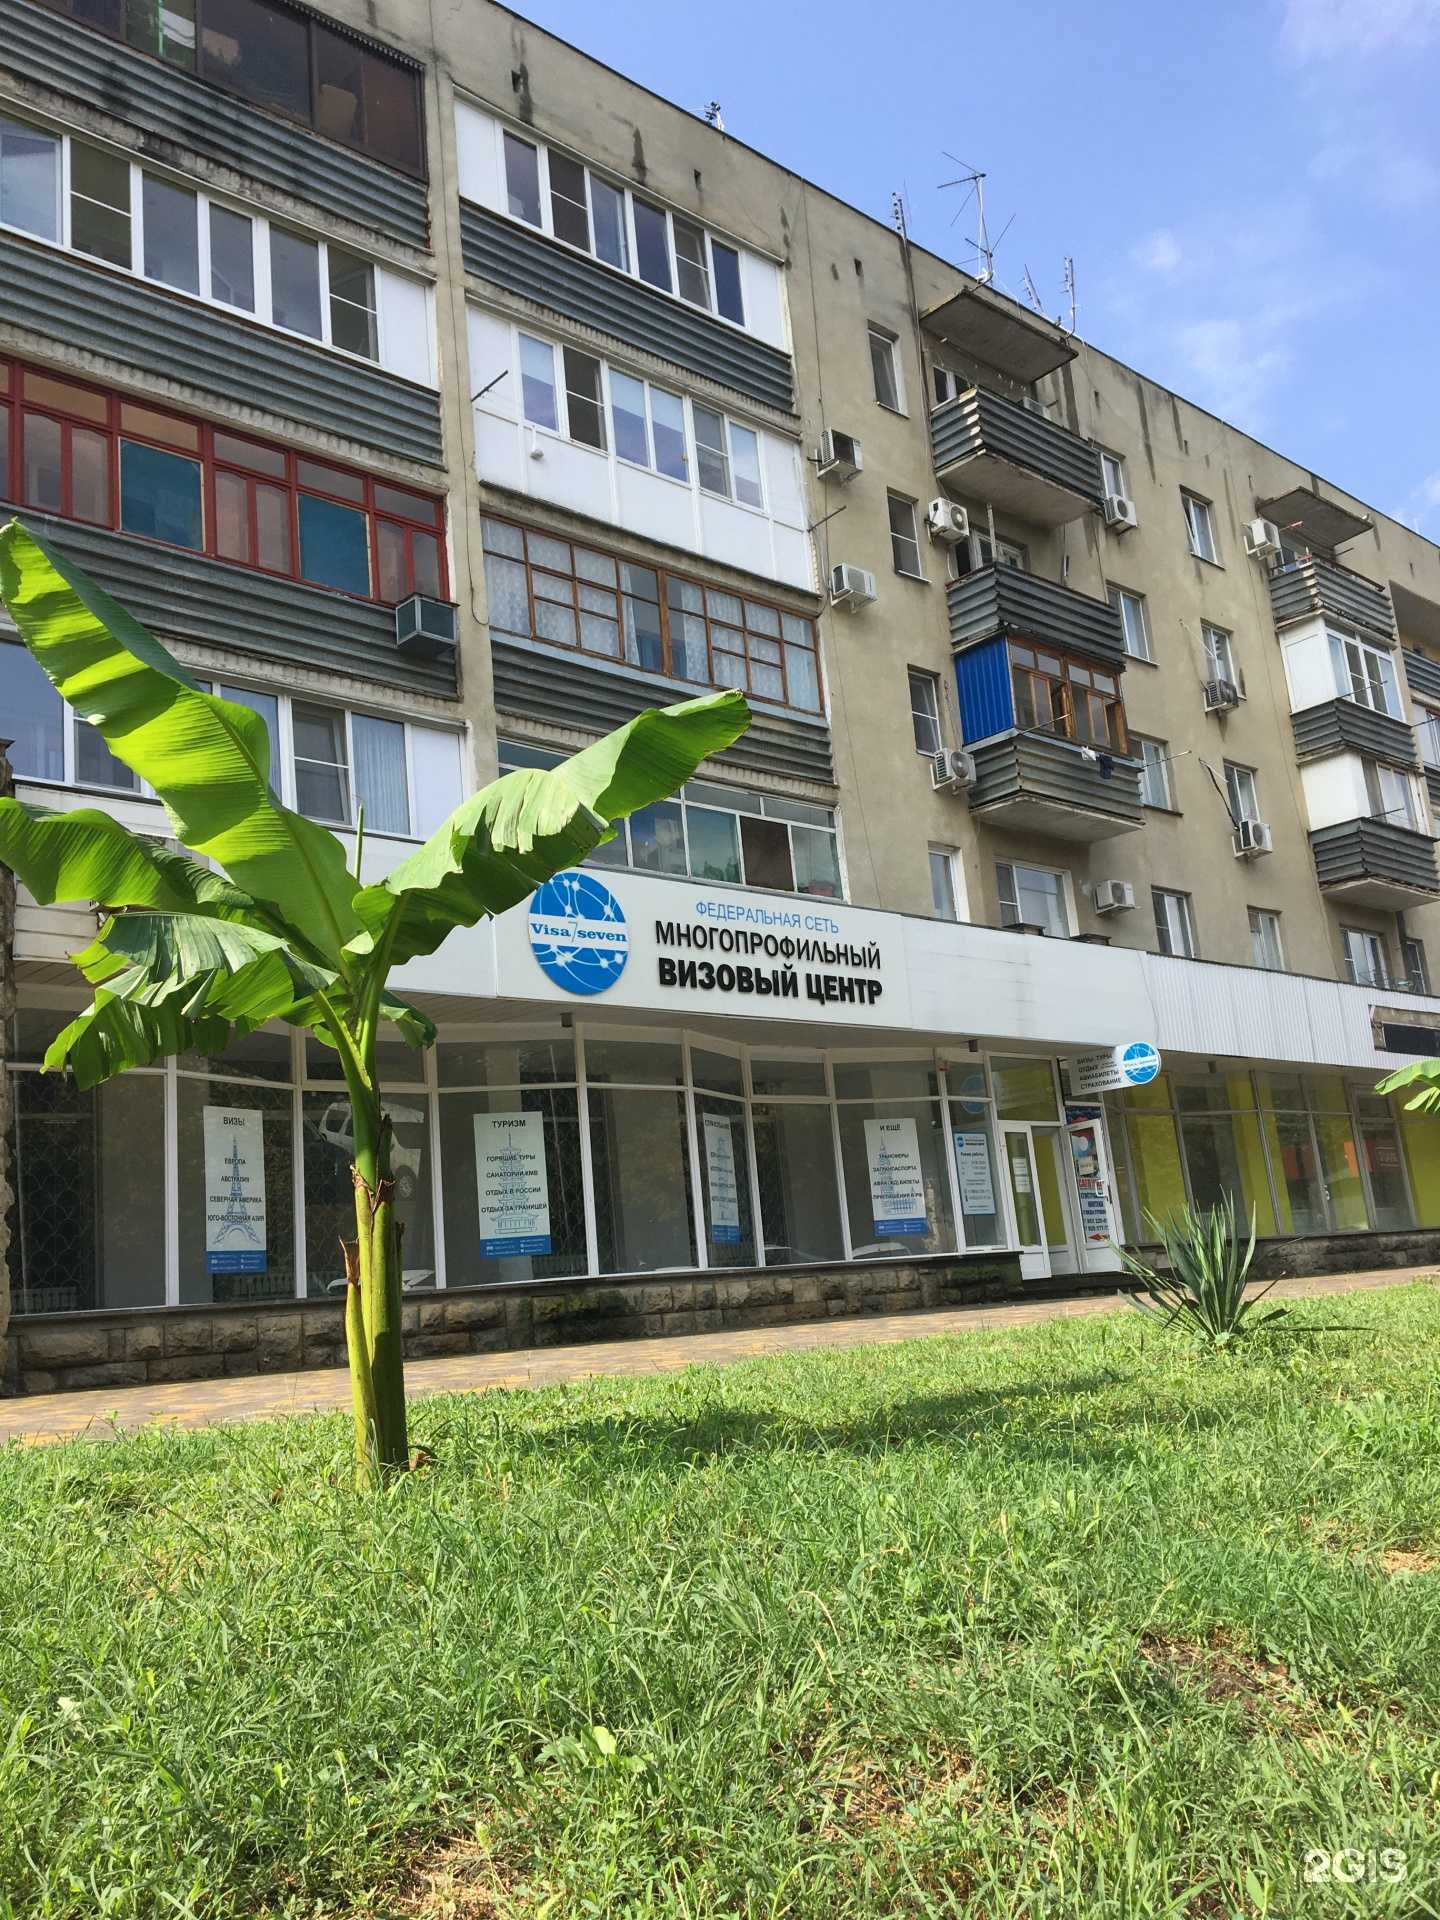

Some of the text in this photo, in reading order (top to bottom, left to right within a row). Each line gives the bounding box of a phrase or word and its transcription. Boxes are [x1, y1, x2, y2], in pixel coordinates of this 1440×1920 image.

[695, 901, 839, 933] ФЕДЕРАЛЬНАЯ СЕТЬ
[655, 920, 882, 970] МНОГОПРОФИЛЬНЫЙ
[658, 957, 883, 1005] ВИЗОВЫЙ ЦЕНТР
[1081, 1078, 1122, 1089] СТРАХОВАНИЕ
[223, 1117, 246, 1126] ВИЗЫ
[492, 1119, 526, 1128] ТУРИЗМ
[486, 1154, 517, 1162] ГОРЯЩИЕ
